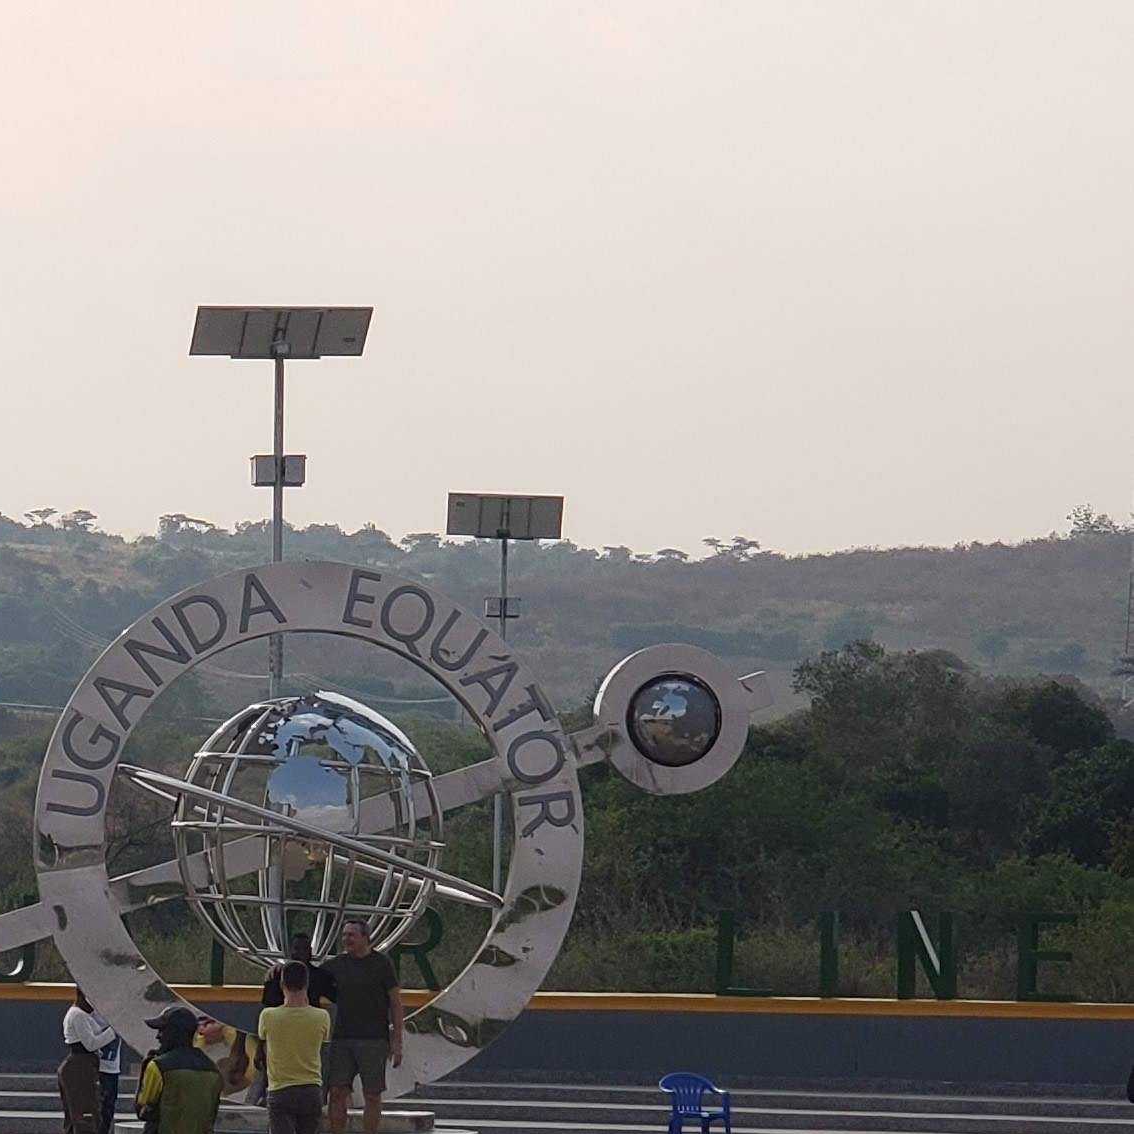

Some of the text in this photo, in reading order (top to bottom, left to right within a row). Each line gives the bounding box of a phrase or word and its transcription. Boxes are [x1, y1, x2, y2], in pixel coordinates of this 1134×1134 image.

[46, 568, 577, 838] UGANDA EQUATOR
[716, 909, 1079, 1001] LINE
